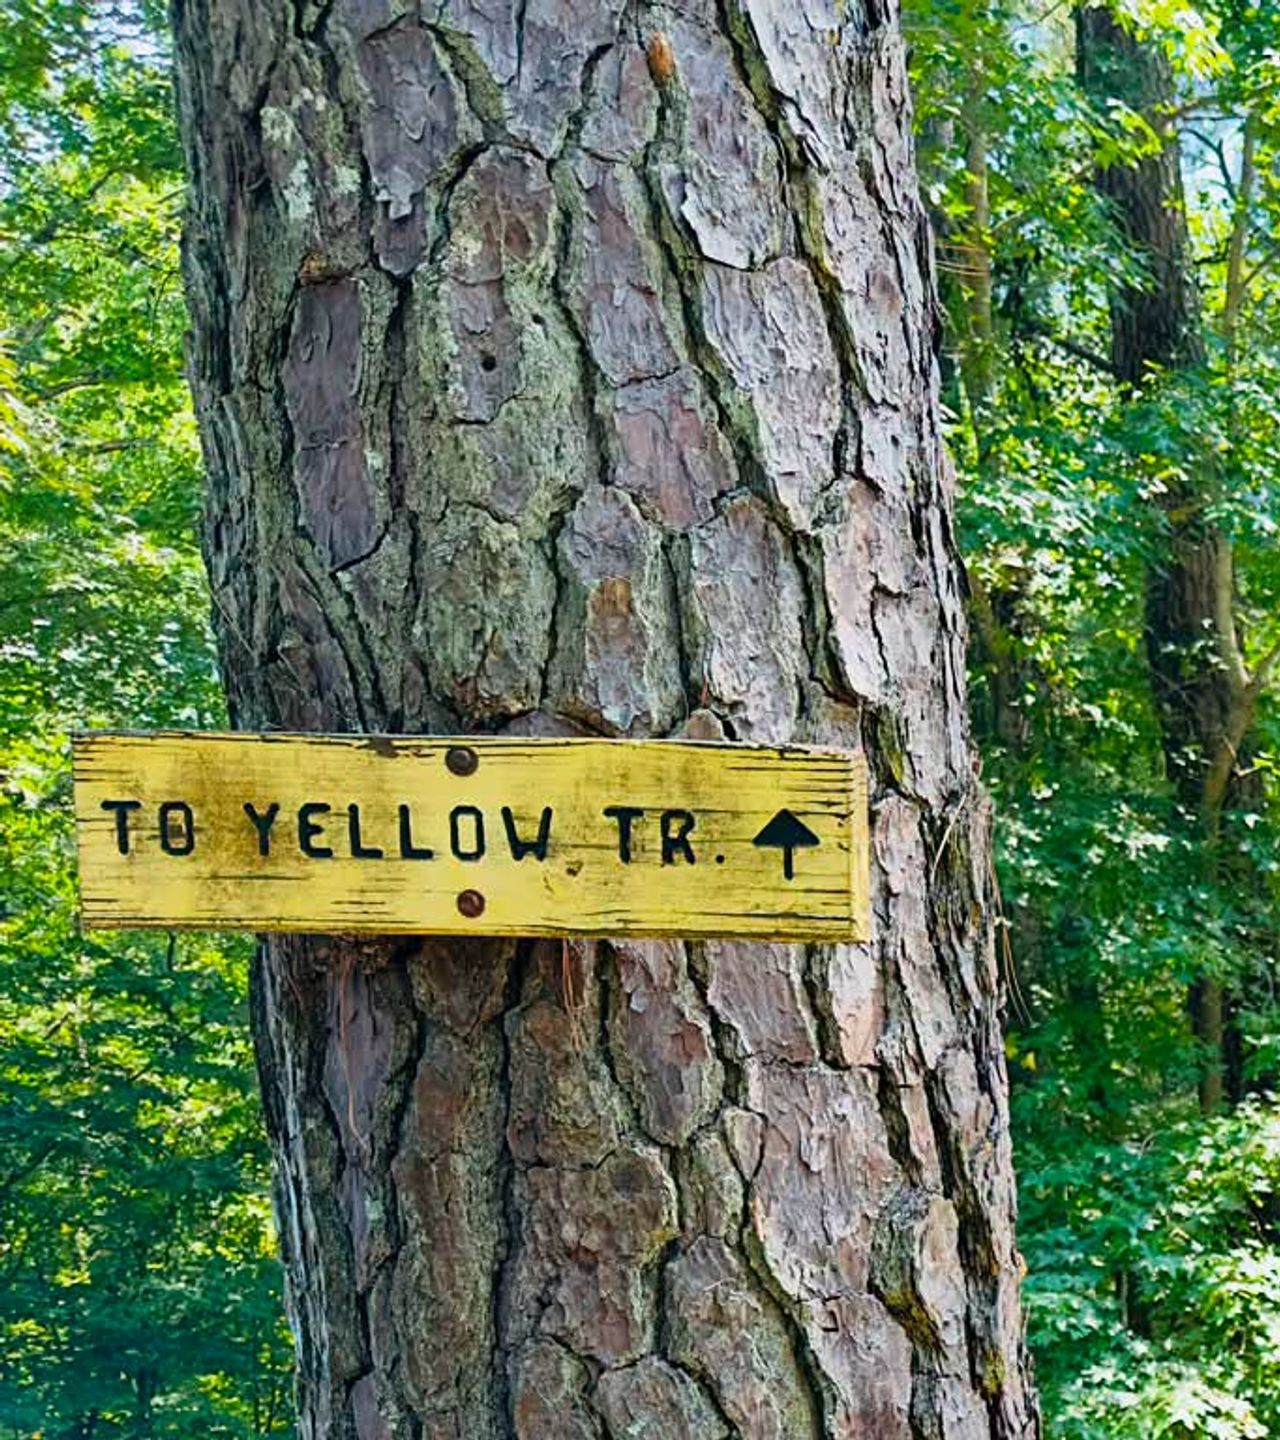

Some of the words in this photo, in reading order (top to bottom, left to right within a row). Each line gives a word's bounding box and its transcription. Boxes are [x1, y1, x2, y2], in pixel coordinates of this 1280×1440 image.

[102, 800, 194, 855] TO
[244, 803, 552, 861] YELLOW
[602, 806, 726, 864] TR.
